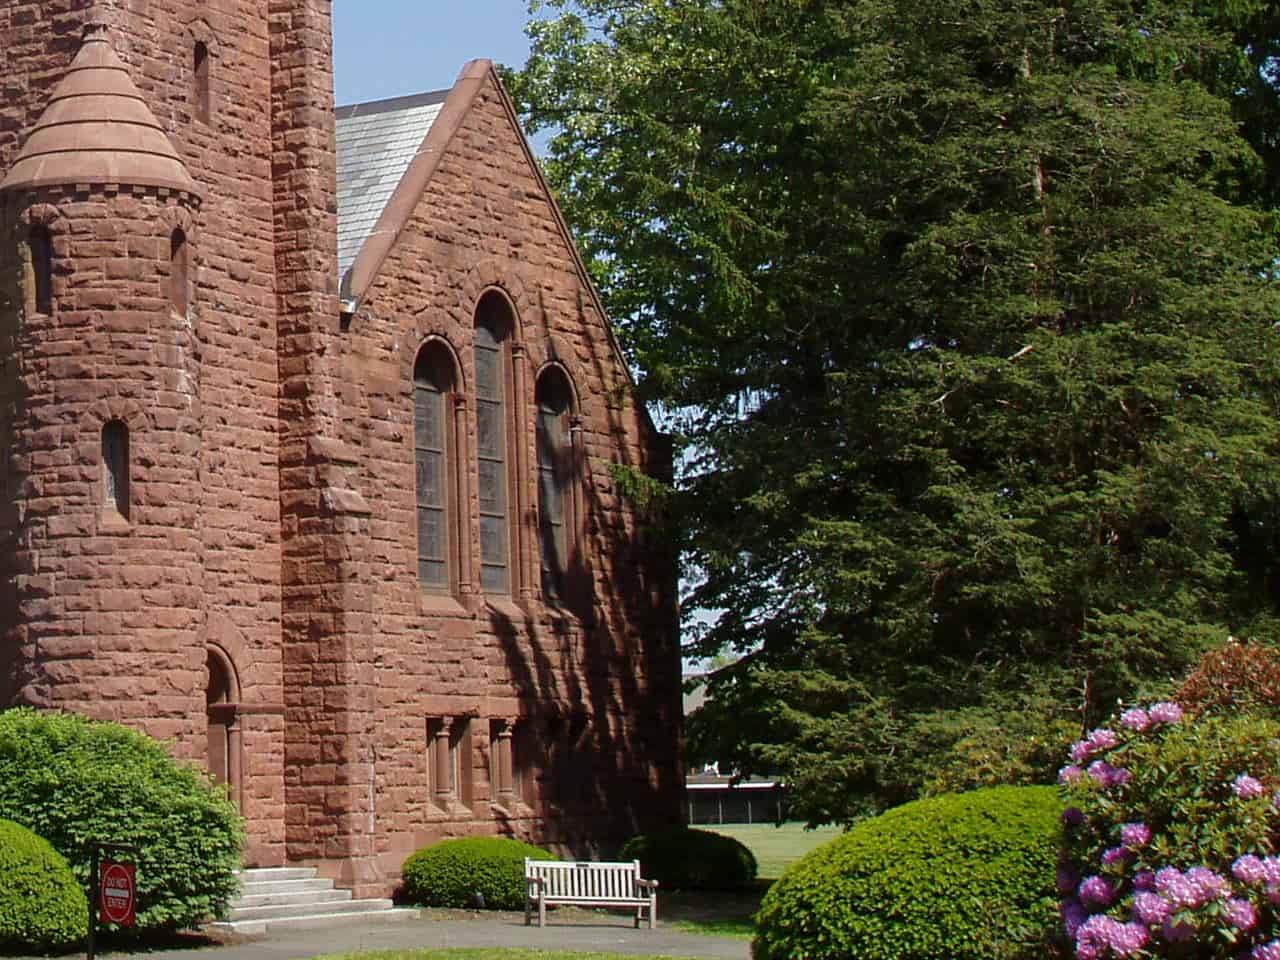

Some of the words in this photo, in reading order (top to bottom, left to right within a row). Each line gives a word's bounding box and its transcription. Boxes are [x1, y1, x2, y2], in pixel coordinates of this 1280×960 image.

[107, 878, 115, 887] DO
[116, 878, 127, 888] NOT
[107, 898, 127, 908] ENTER
